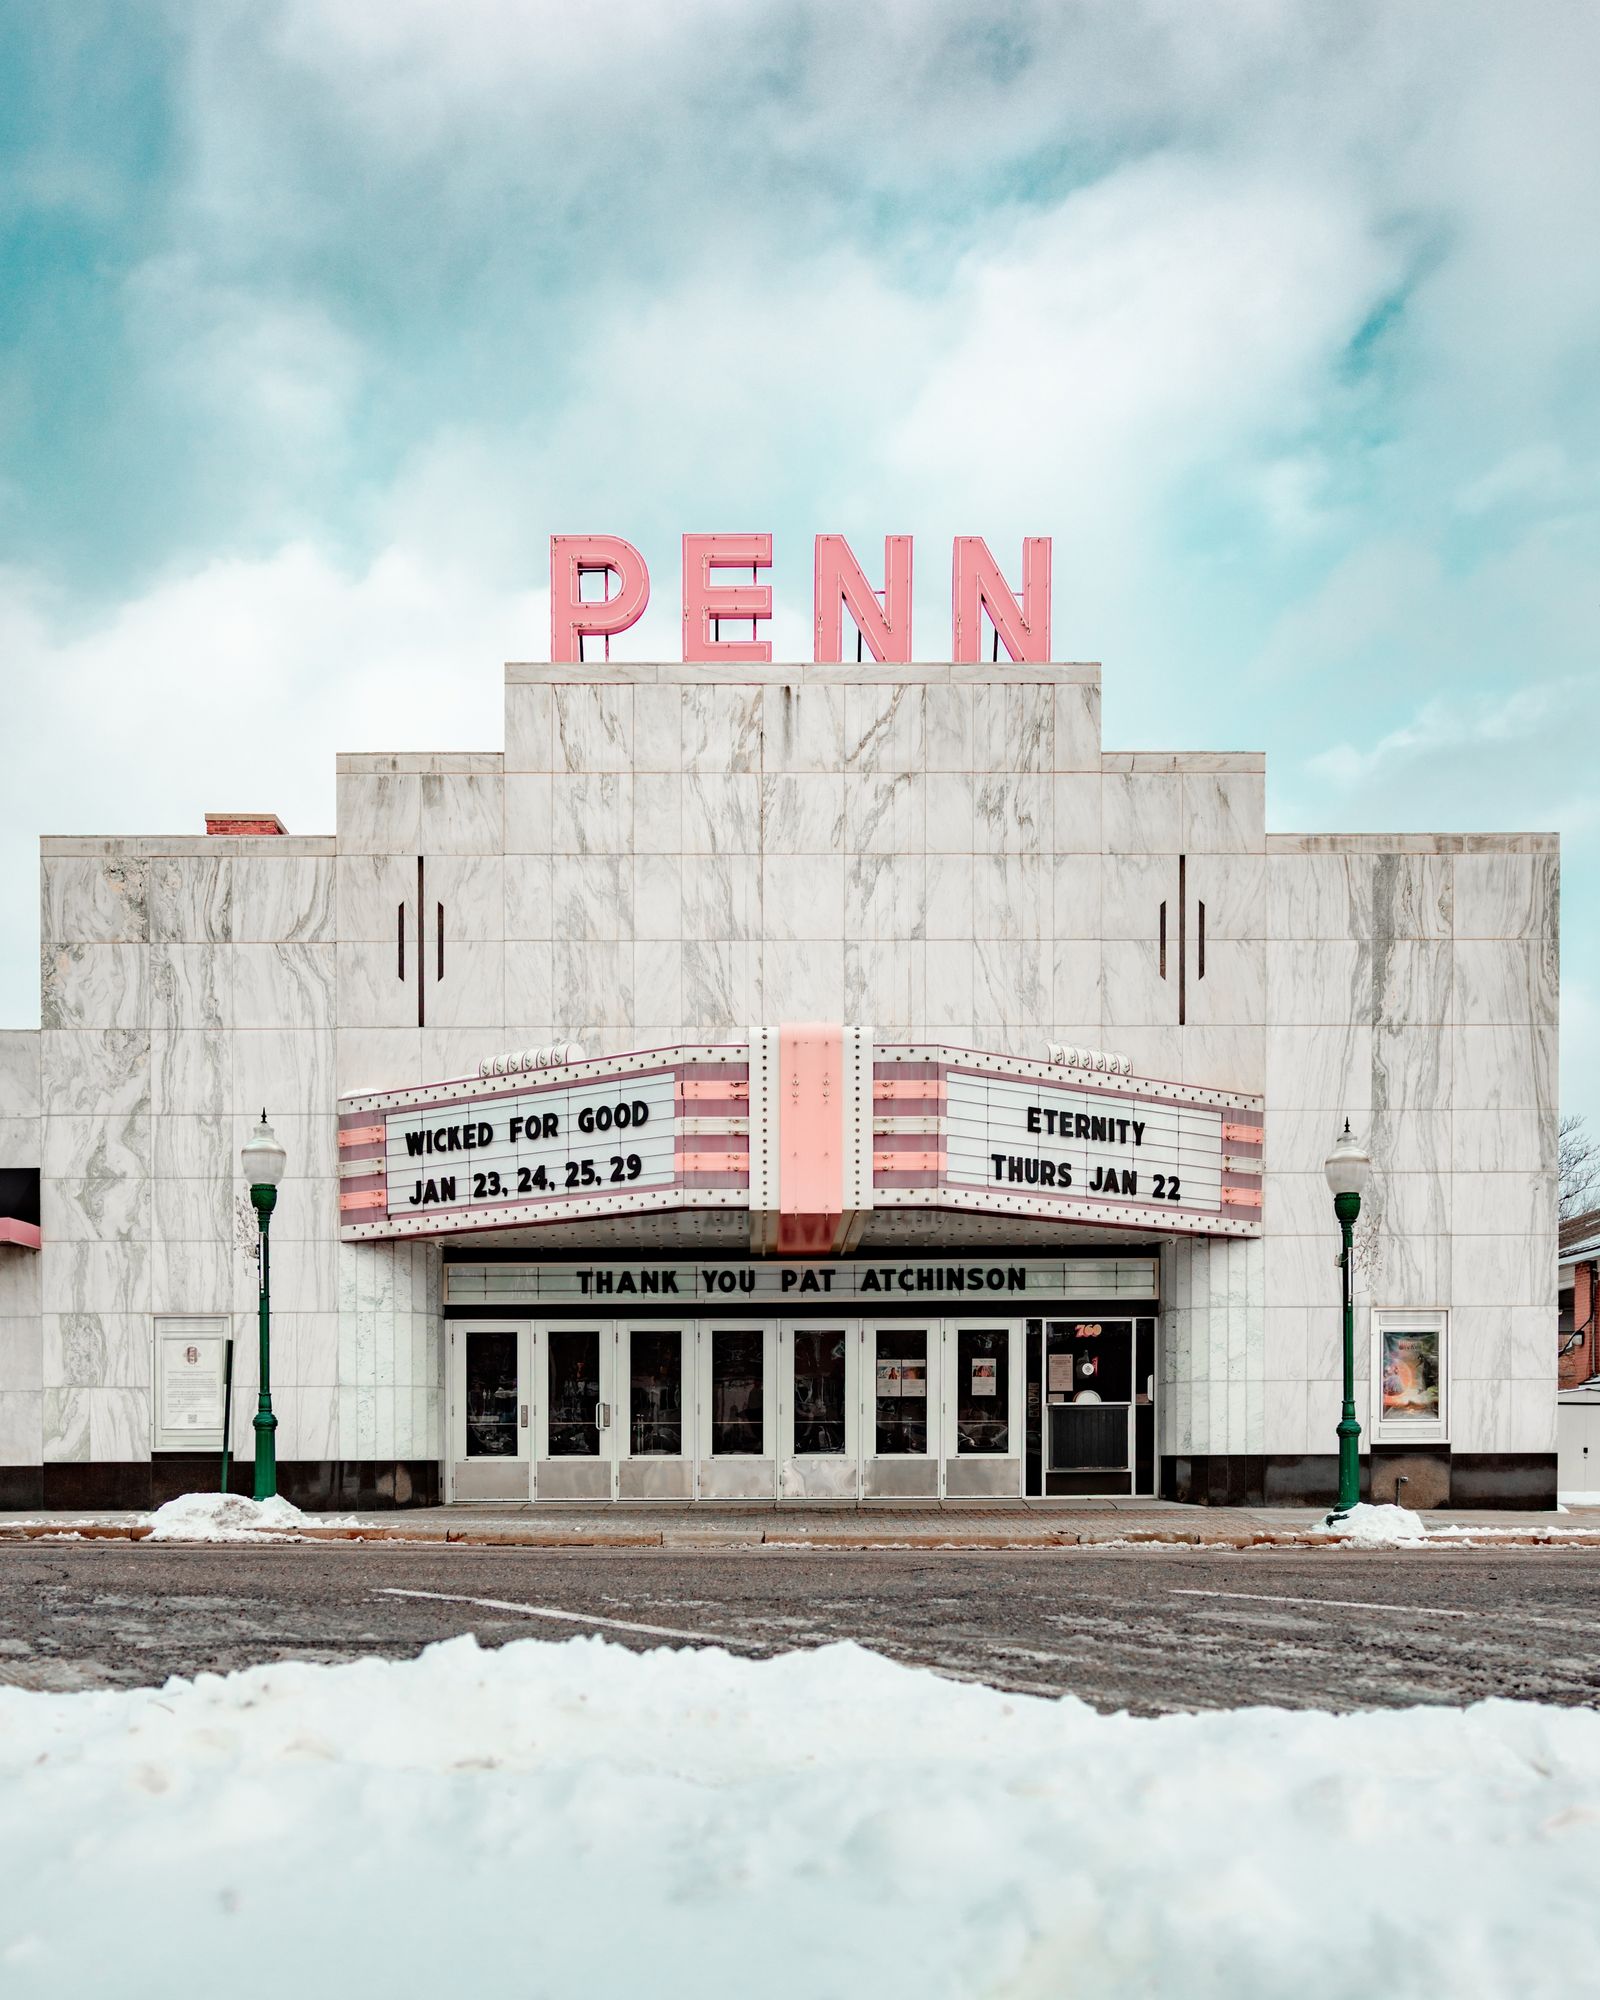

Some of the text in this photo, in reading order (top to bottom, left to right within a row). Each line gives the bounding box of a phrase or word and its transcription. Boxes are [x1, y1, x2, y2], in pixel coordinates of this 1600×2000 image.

[550, 533, 1052, 663] PENN
[405, 1100, 649, 1157] WICKED FOR GOOD
[1027, 1106, 1145, 1146] ETERNITY
[409, 1153, 642, 1205] JAN 23, 24, 25, 29
[991, 1153, 1181, 1201] THURS JAN 22
[576, 1267, 1027, 1294] THANK YOU PAT ATCHINSON
